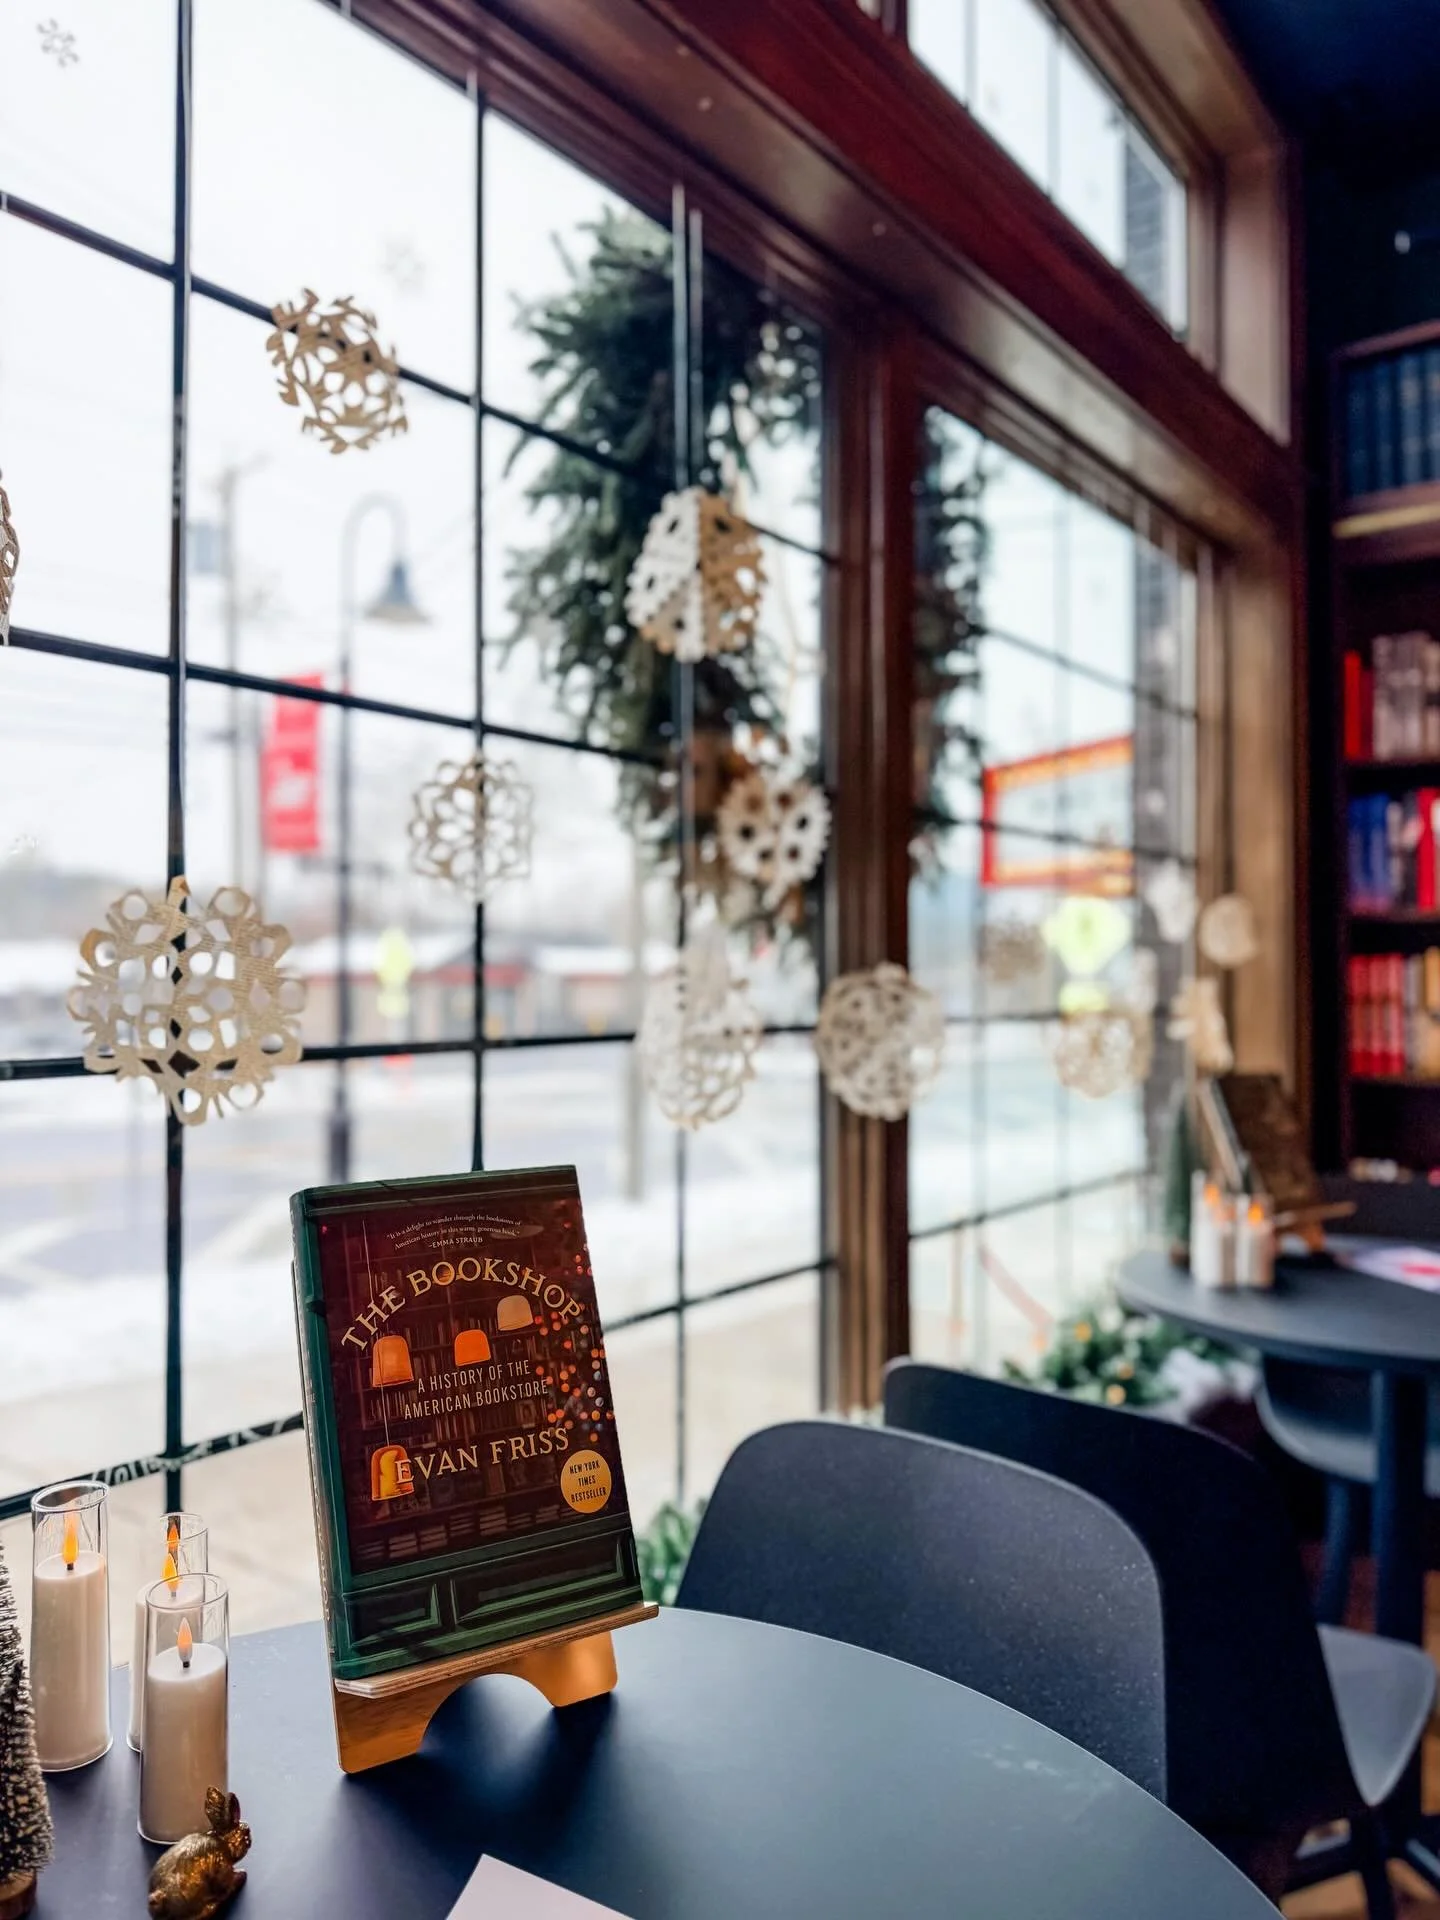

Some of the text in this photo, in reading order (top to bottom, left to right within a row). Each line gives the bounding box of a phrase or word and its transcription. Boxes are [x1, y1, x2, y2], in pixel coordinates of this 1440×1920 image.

[406, 1222, 424, 1233] delight
[433, 1216, 452, 1224] wander
[453, 1213, 476, 1222] through
[486, 1214, 514, 1225] bookstores
[395, 1236, 421, 1250] American
[421, 1231, 440, 1239] history
[456, 1237, 483, 1245] STRAUB
[341, 1257, 581, 1351] THE BOOKSHOP
[418, 1360, 531, 1394] A HISTORY OF THE
[404, 1379, 549, 1420] AMERICAN BOOKSTORE
[394, 1427, 569, 1485] EVAN FRISS
[569, 1460, 600, 1474] NEW YORK
[578, 1475, 596, 1487] TIMES
[571, 1487, 606, 1503] BESTSELLER
